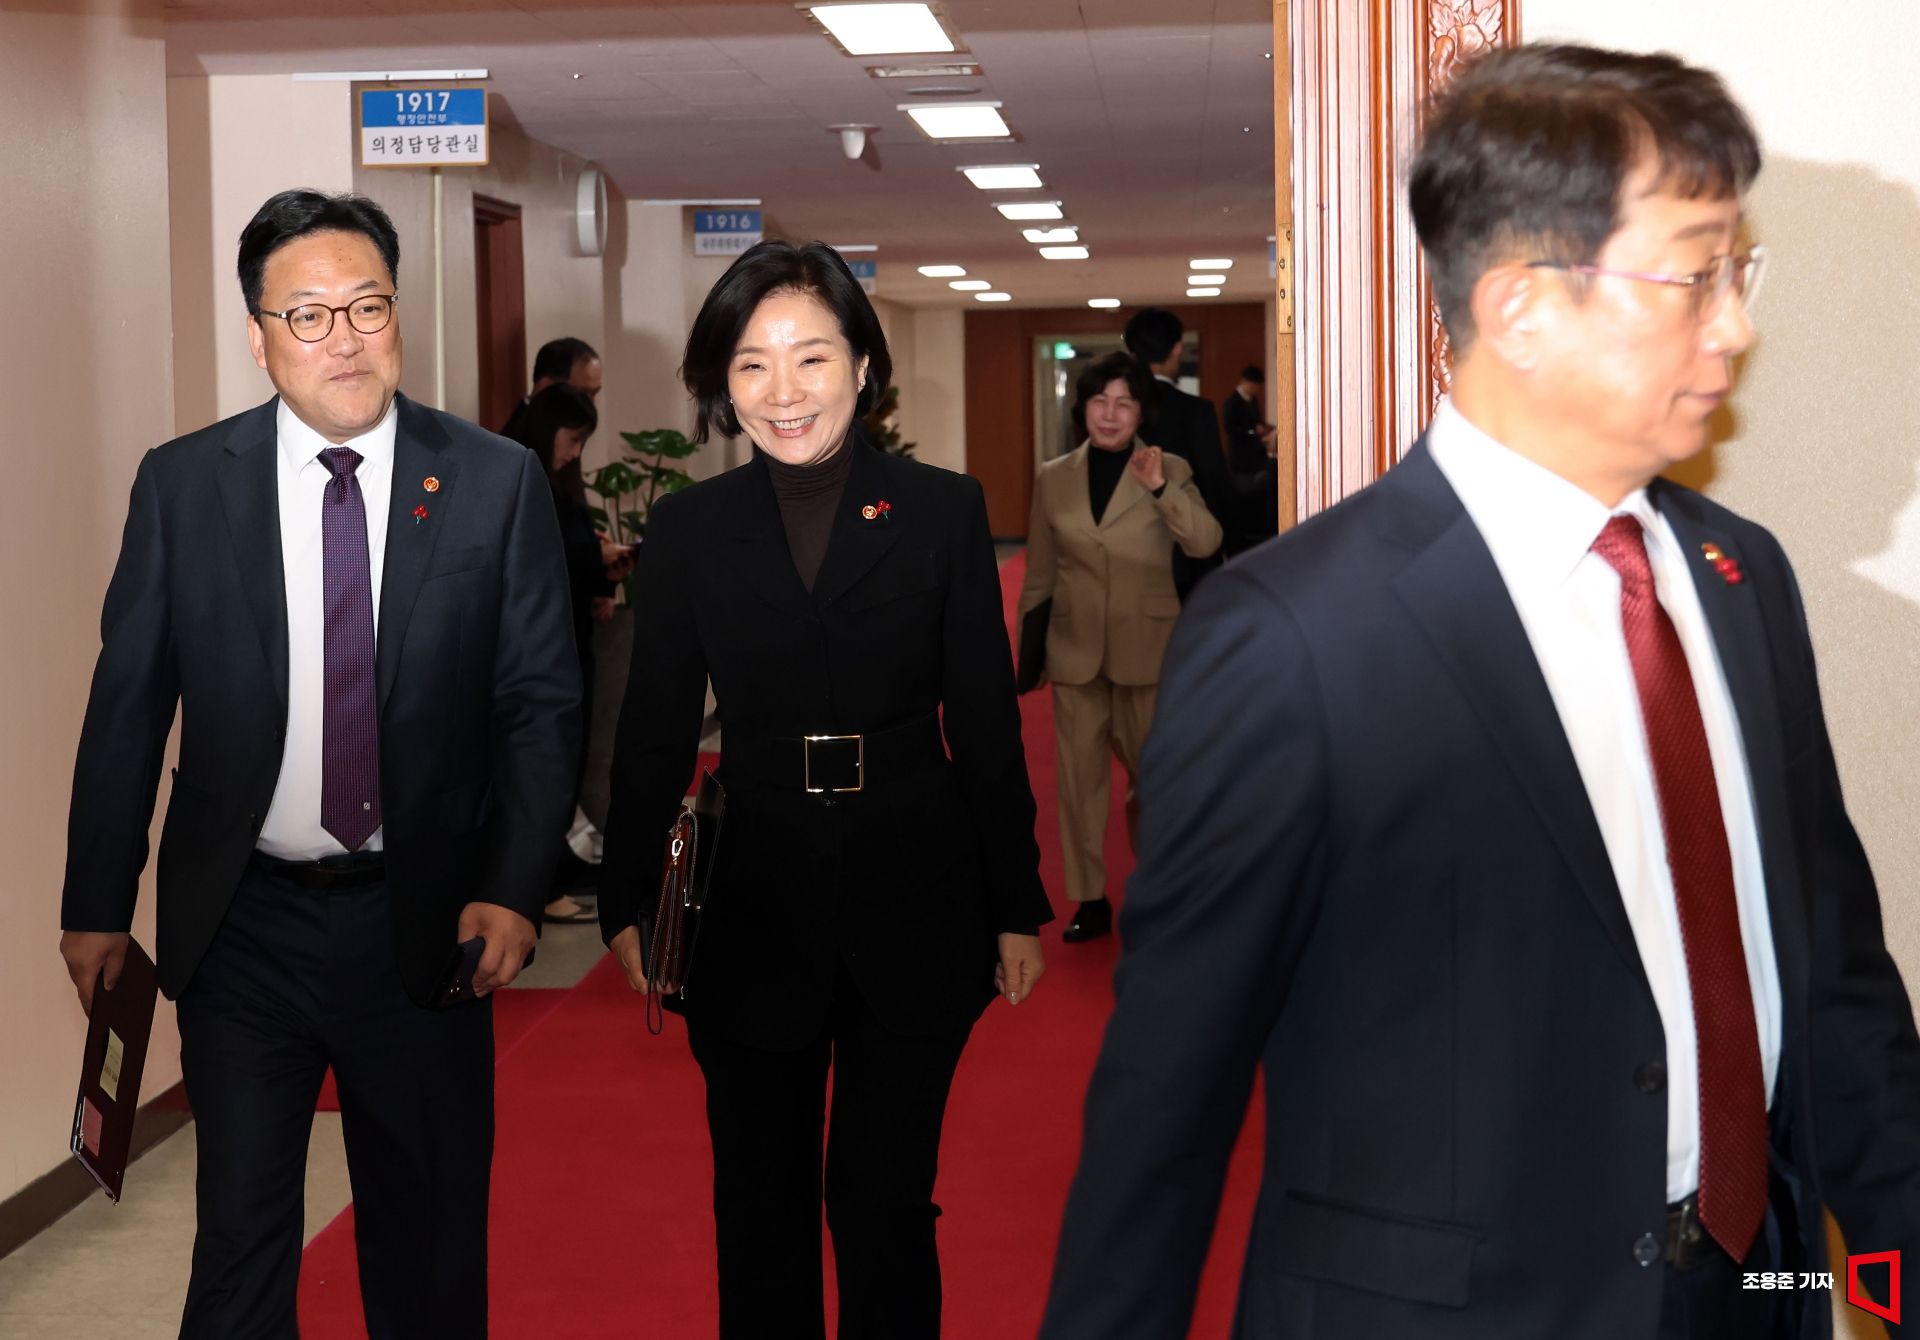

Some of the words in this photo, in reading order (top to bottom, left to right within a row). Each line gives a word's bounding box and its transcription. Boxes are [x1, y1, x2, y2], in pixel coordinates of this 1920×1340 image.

[396, 92, 450, 112] 1917
[372, 134, 478, 154] 의정담당관실
[707, 214, 751, 230] 1916
